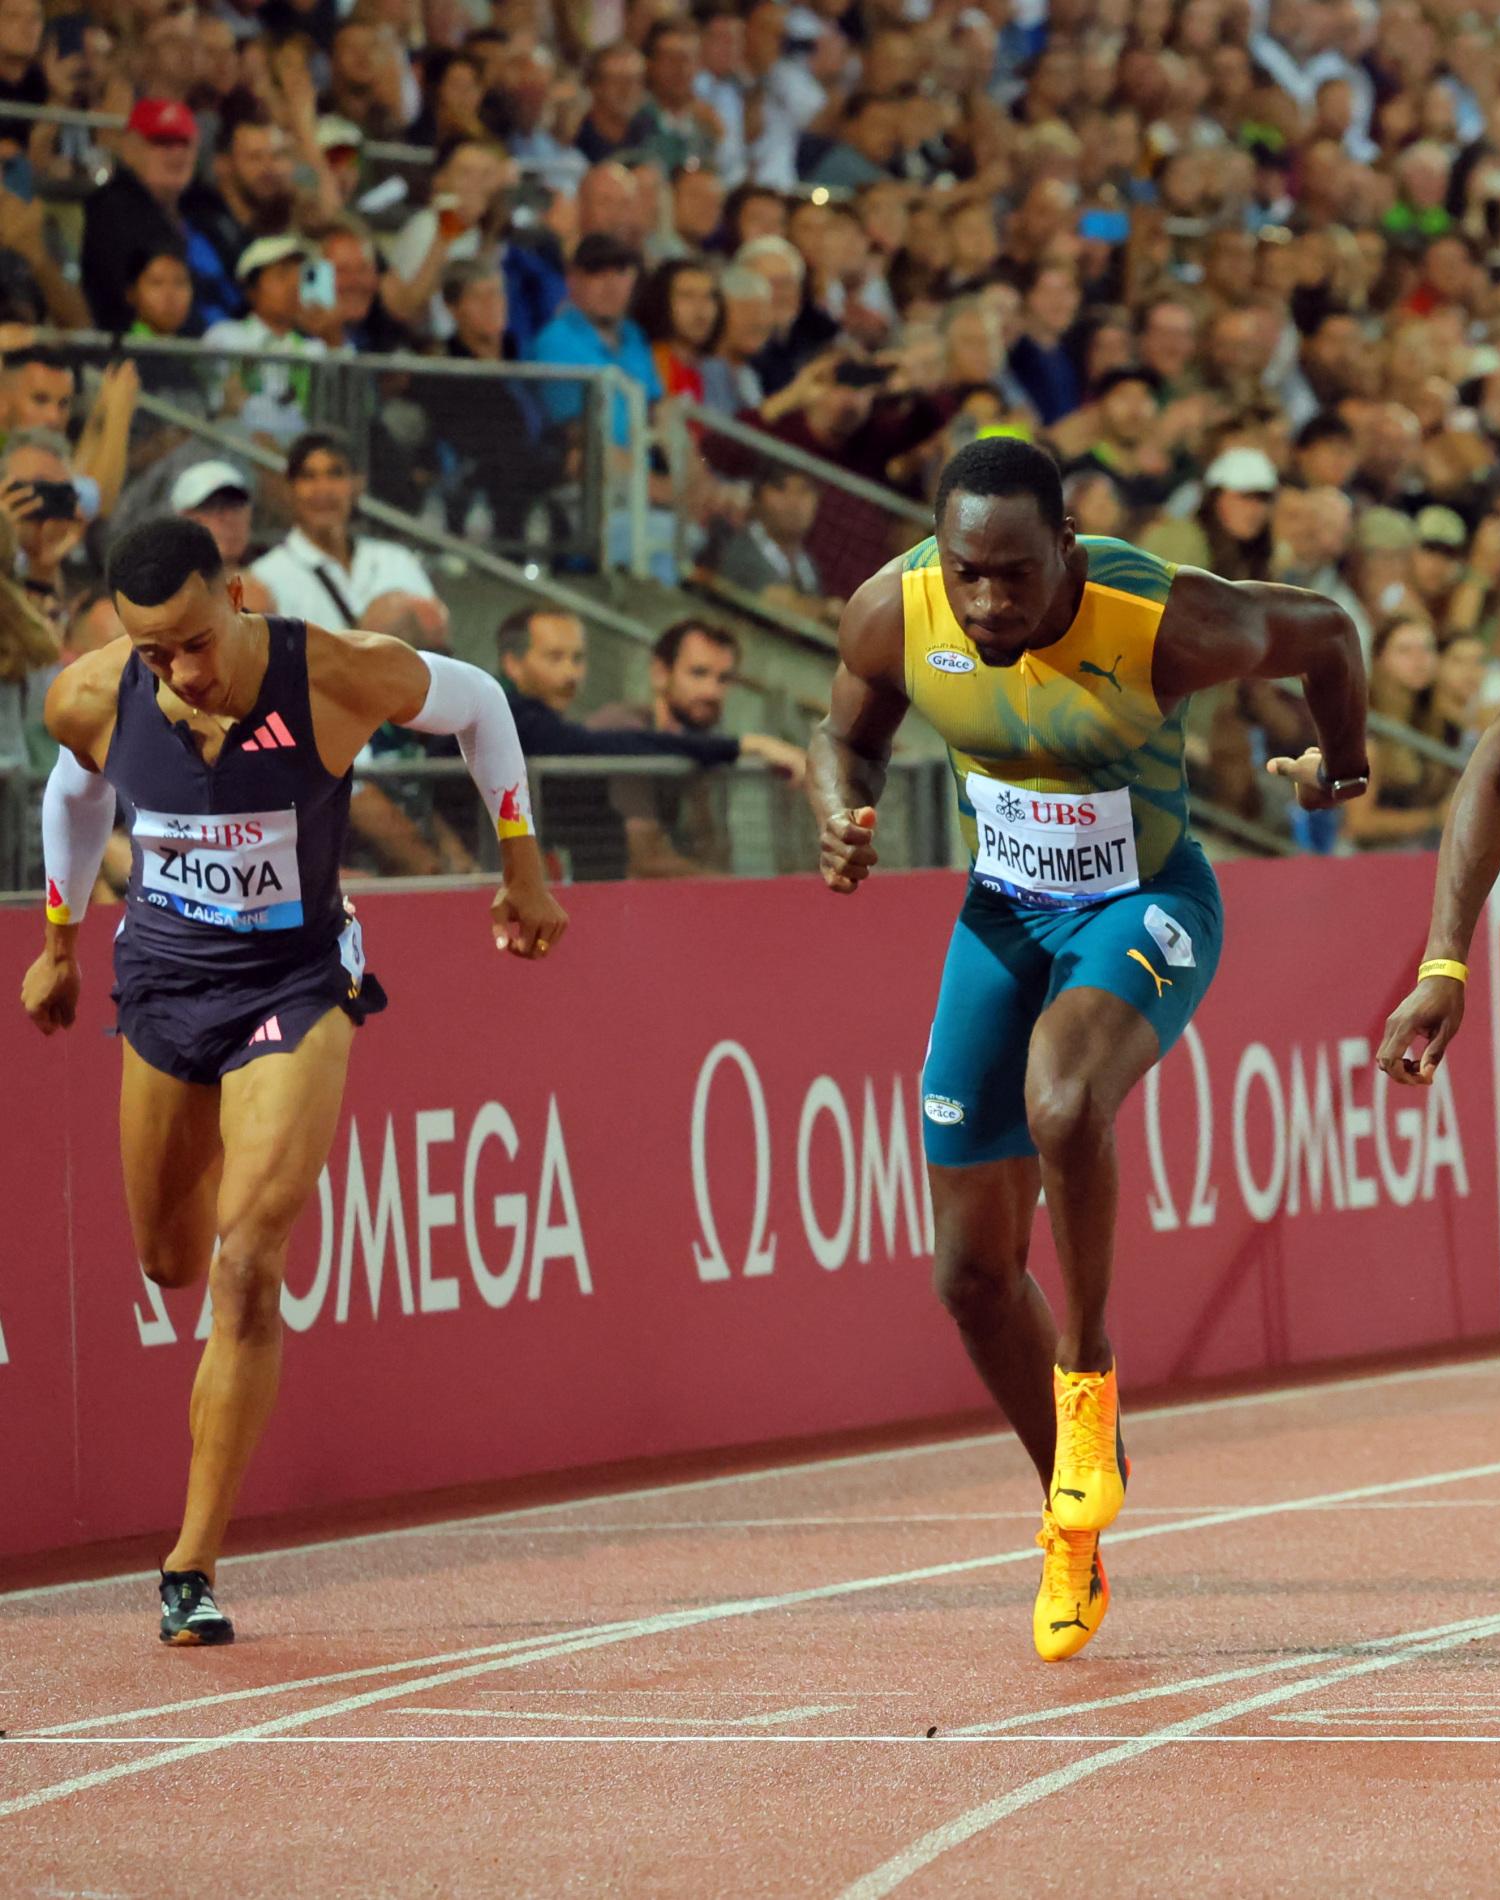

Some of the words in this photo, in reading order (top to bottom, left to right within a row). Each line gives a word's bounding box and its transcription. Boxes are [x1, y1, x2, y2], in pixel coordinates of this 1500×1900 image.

[932, 655, 970, 670] Grace
[1031, 800, 1097, 826] UBS
[200, 820, 263, 848] UBS
[984, 824, 1127, 883] PARCHMENT
[159, 847, 283, 897] ZHOYA
[1233, 1037, 1469, 1222] OMEGA
